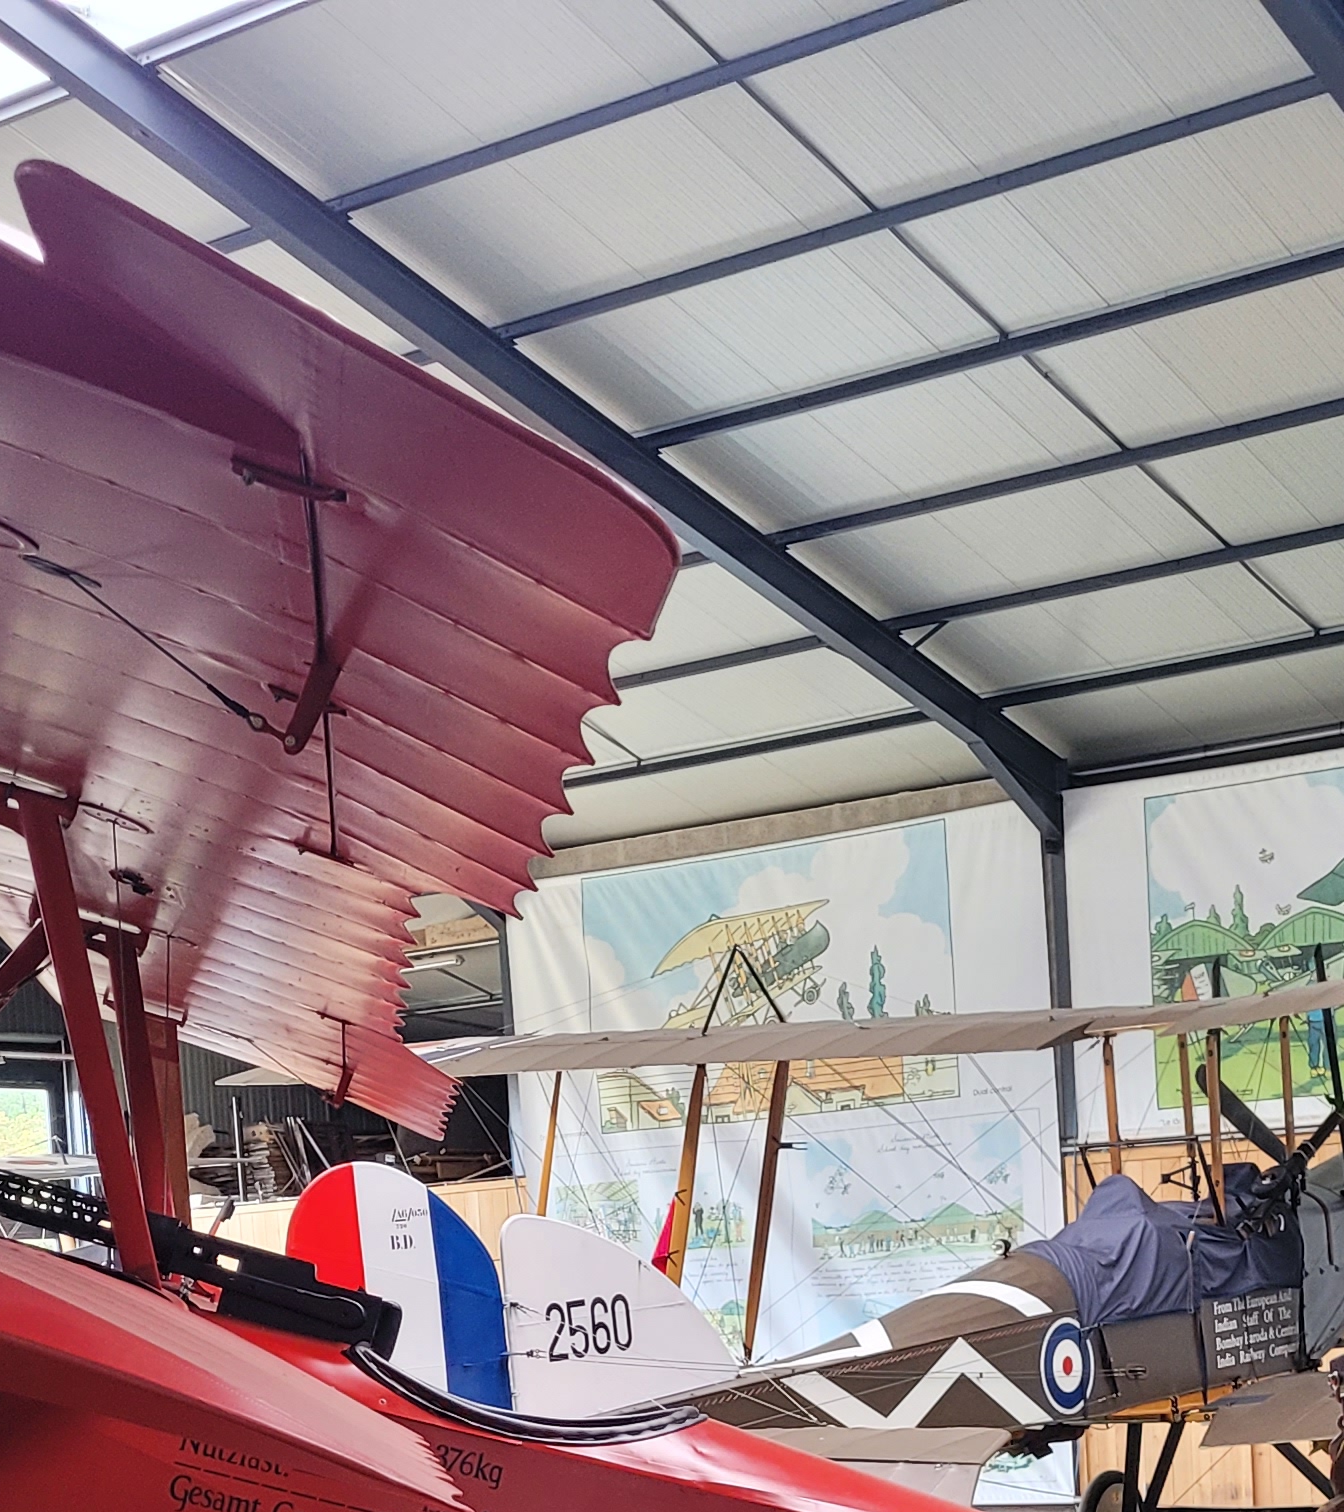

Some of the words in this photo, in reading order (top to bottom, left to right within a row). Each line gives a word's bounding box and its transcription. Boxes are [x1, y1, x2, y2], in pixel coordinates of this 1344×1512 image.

[1213, 1301, 1232, 1315] From
[1246, 1294, 1277, 1310] European
[1278, 1287, 1293, 1302] And
[545, 1293, 633, 1363] 2560
[1215, 1317, 1237, 1333] Indian
[1263, 1308, 1275, 1323] Of
[1278, 1306, 1292, 1320] The
[1216, 1334, 1243, 1351] Bombay
[1217, 1352, 1235, 1369] India
